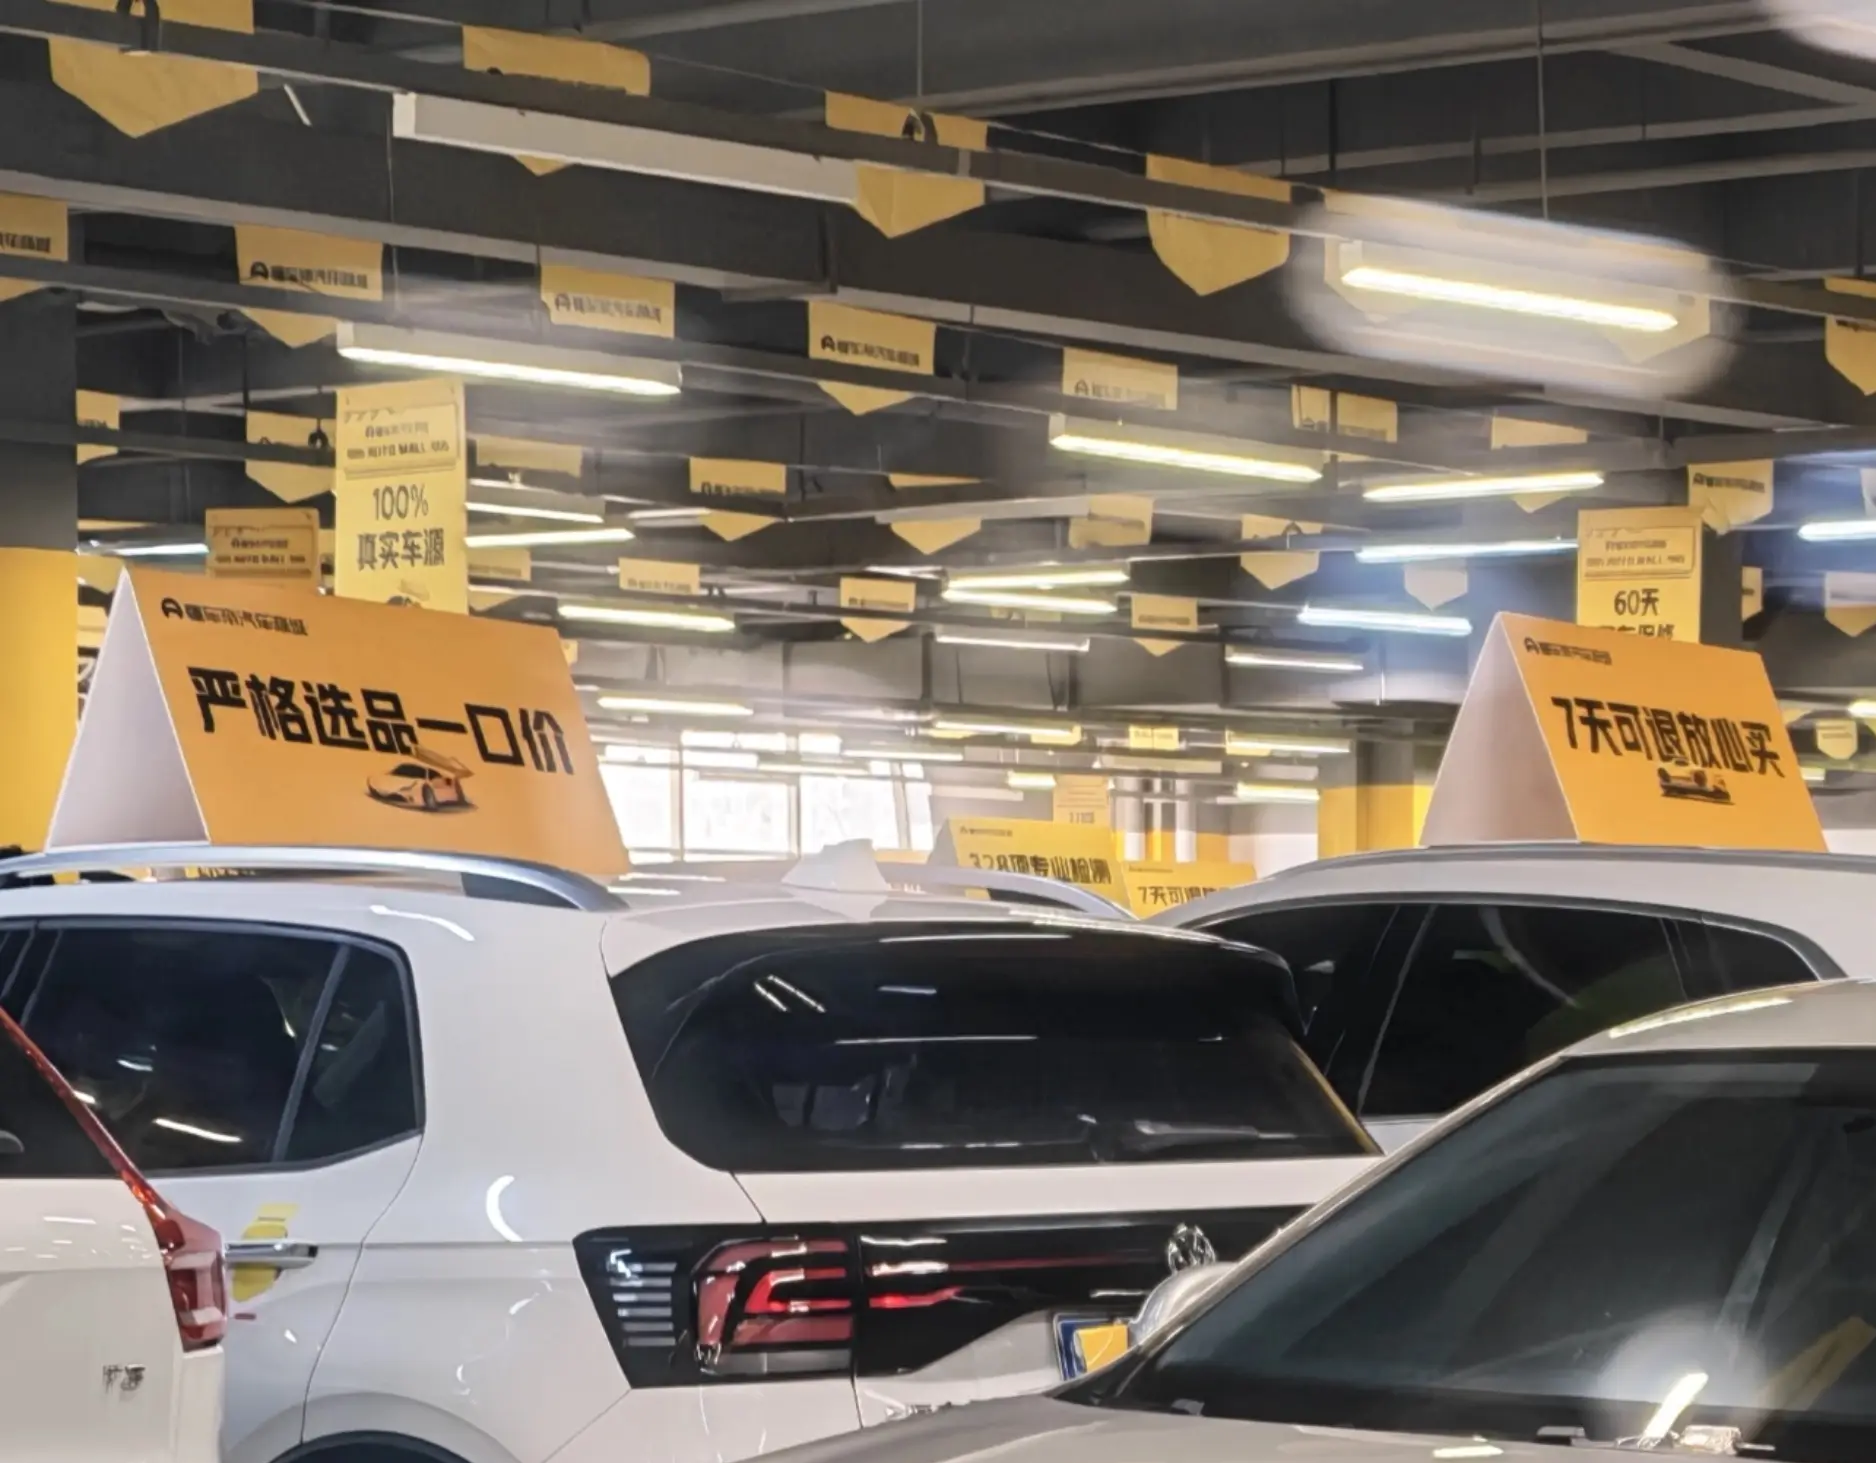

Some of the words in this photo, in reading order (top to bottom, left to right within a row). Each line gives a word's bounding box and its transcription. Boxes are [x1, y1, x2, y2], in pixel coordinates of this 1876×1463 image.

[373, 483, 429, 520] 100%
[358, 528, 445, 571] 真实车源
[1613, 588, 1660, 616] 60天
[187, 666, 573, 776] 严格选品一口价
[1551, 697, 1785, 778] 7天可退放心买
